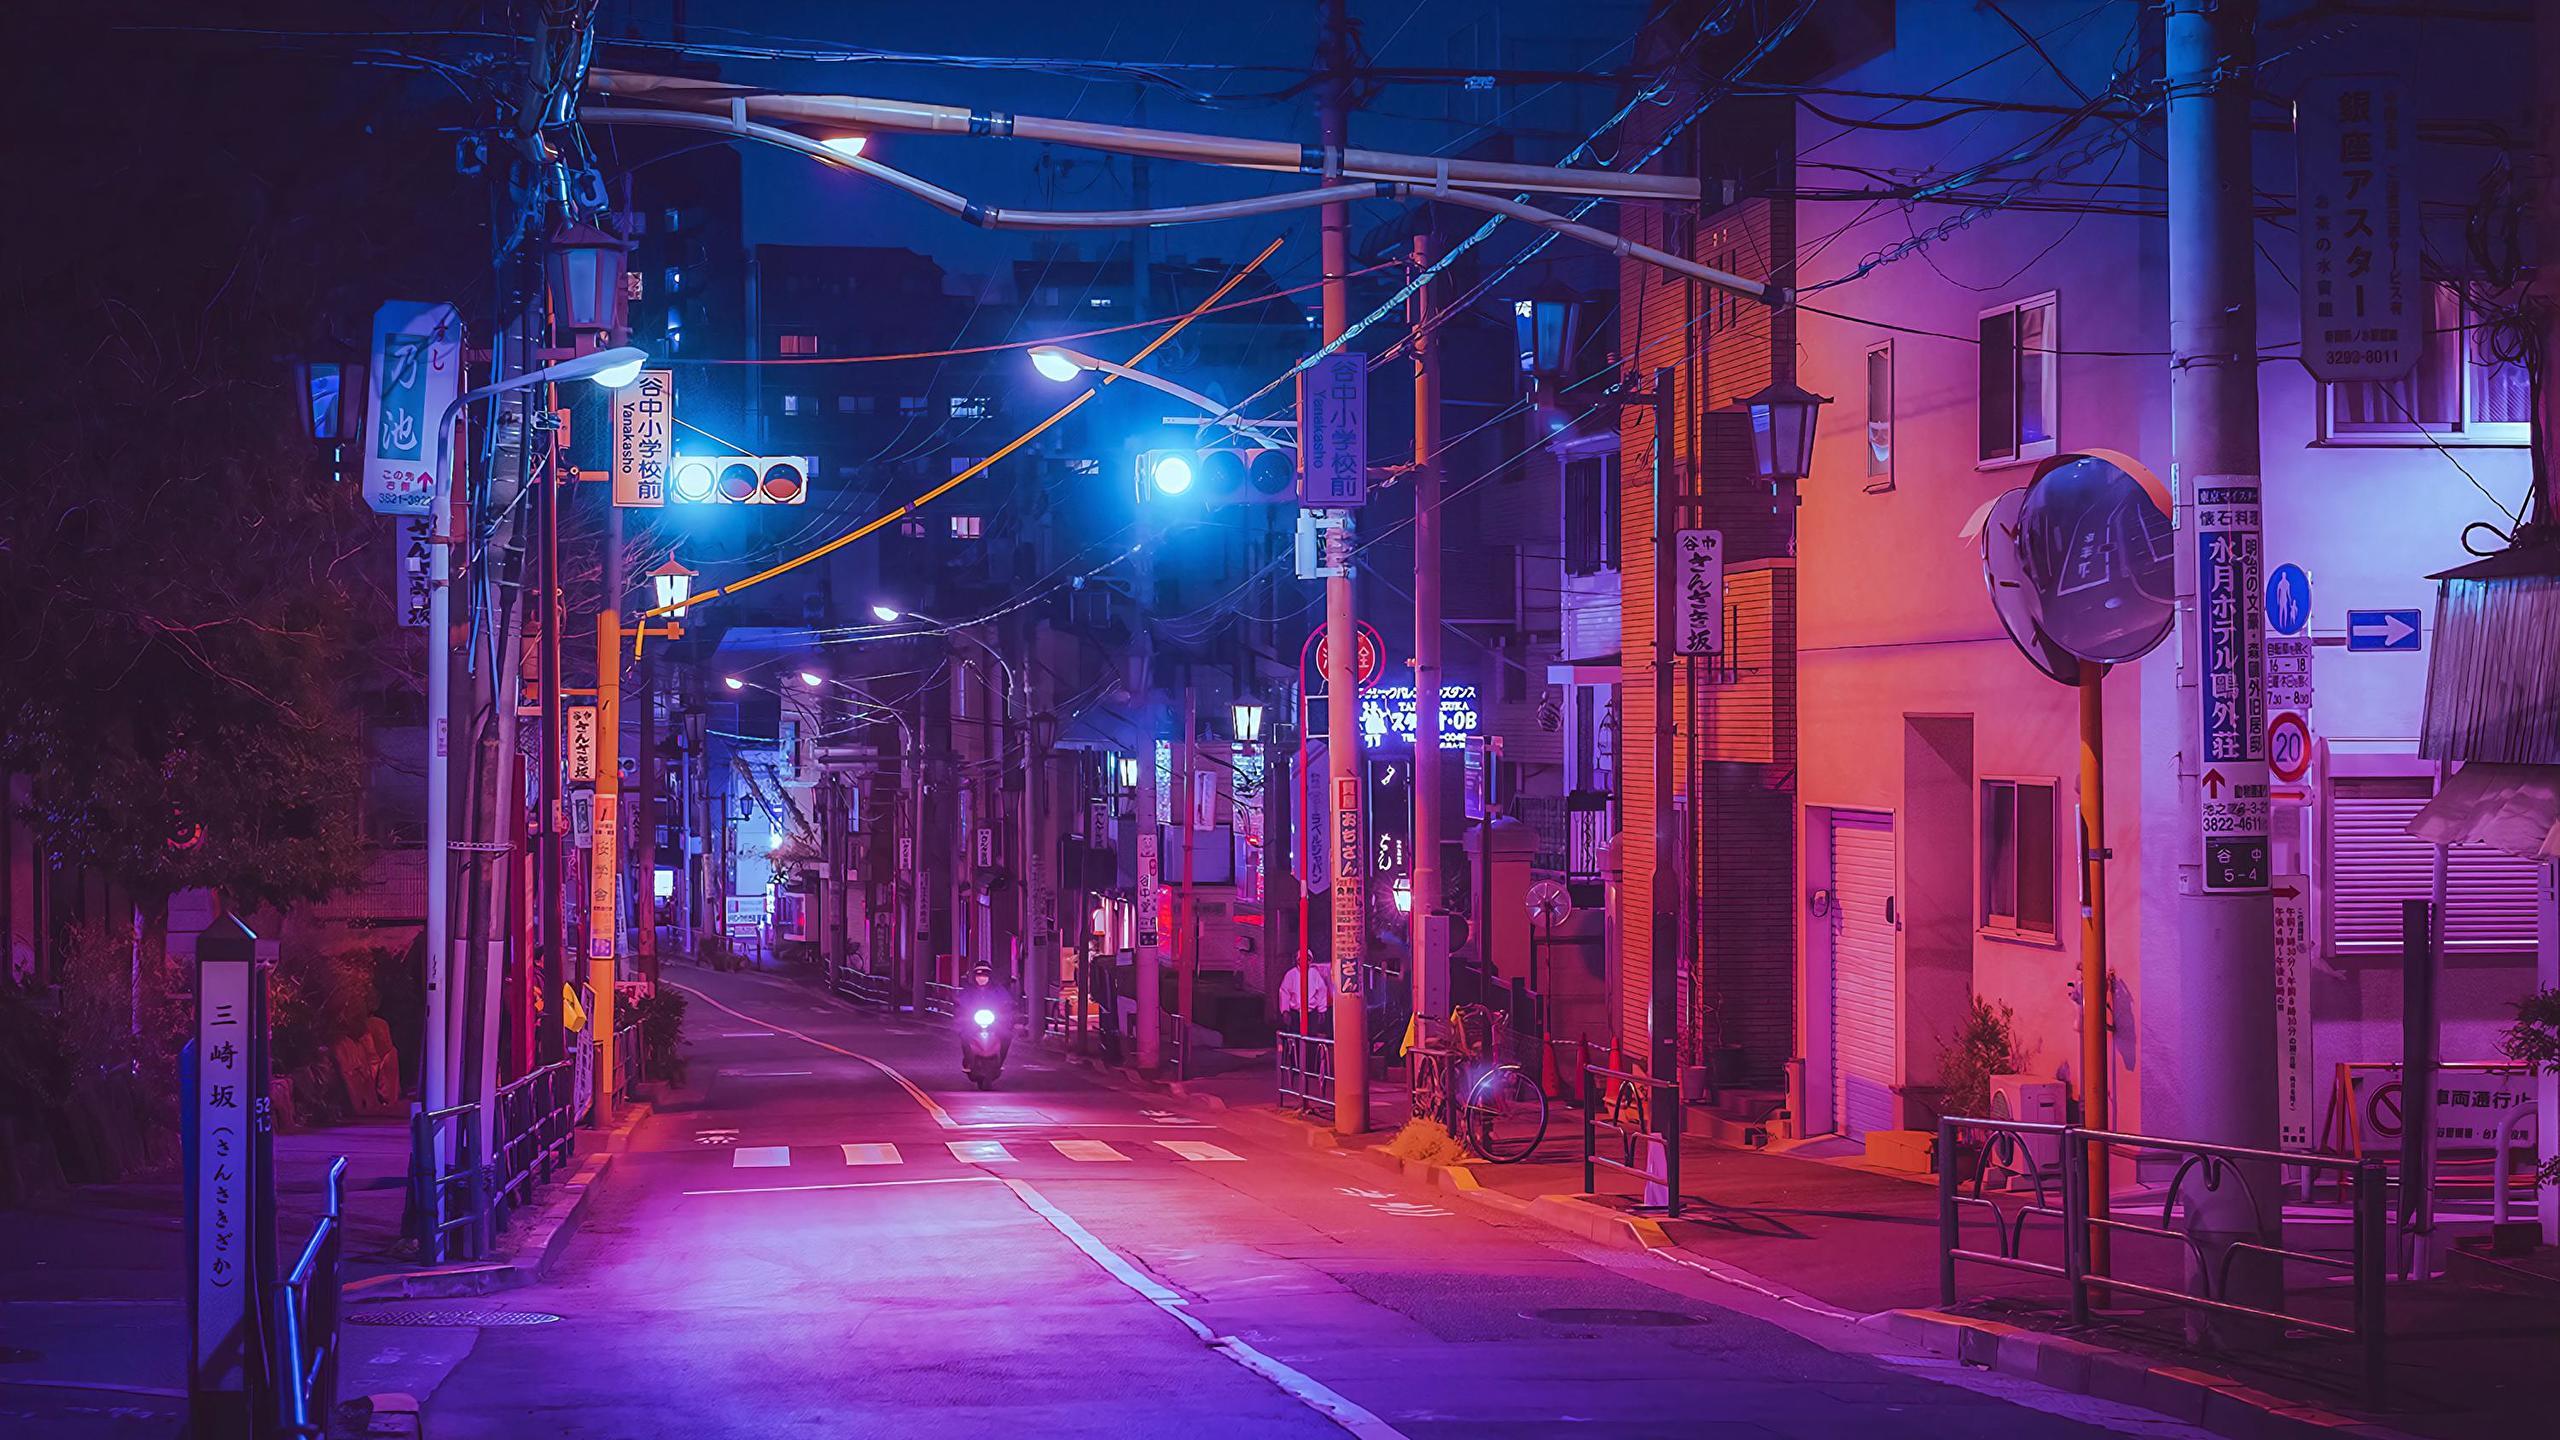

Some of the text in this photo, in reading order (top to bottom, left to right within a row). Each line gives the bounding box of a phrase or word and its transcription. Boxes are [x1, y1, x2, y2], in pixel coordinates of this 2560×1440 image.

[2338, 91, 2373, 317] 銀座アスター
[433, 319, 449, 370] すし
[383, 344, 418, 451] 乃池
[1313, 389, 1327, 469] Yanakasho
[1330, 360, 1358, 497] 谷中小学校前
[622, 402, 635, 474] Yanakasho
[638, 377, 663, 499] 谷中小学校前
[1683, 535, 1717, 551] 谷中
[1687, 552, 1713, 651] さんさき坂
[2275, 732, 2301, 762] 20
[2216, 848, 2262, 863] 谷中
[2224, 867, 2258, 882] 5-4
